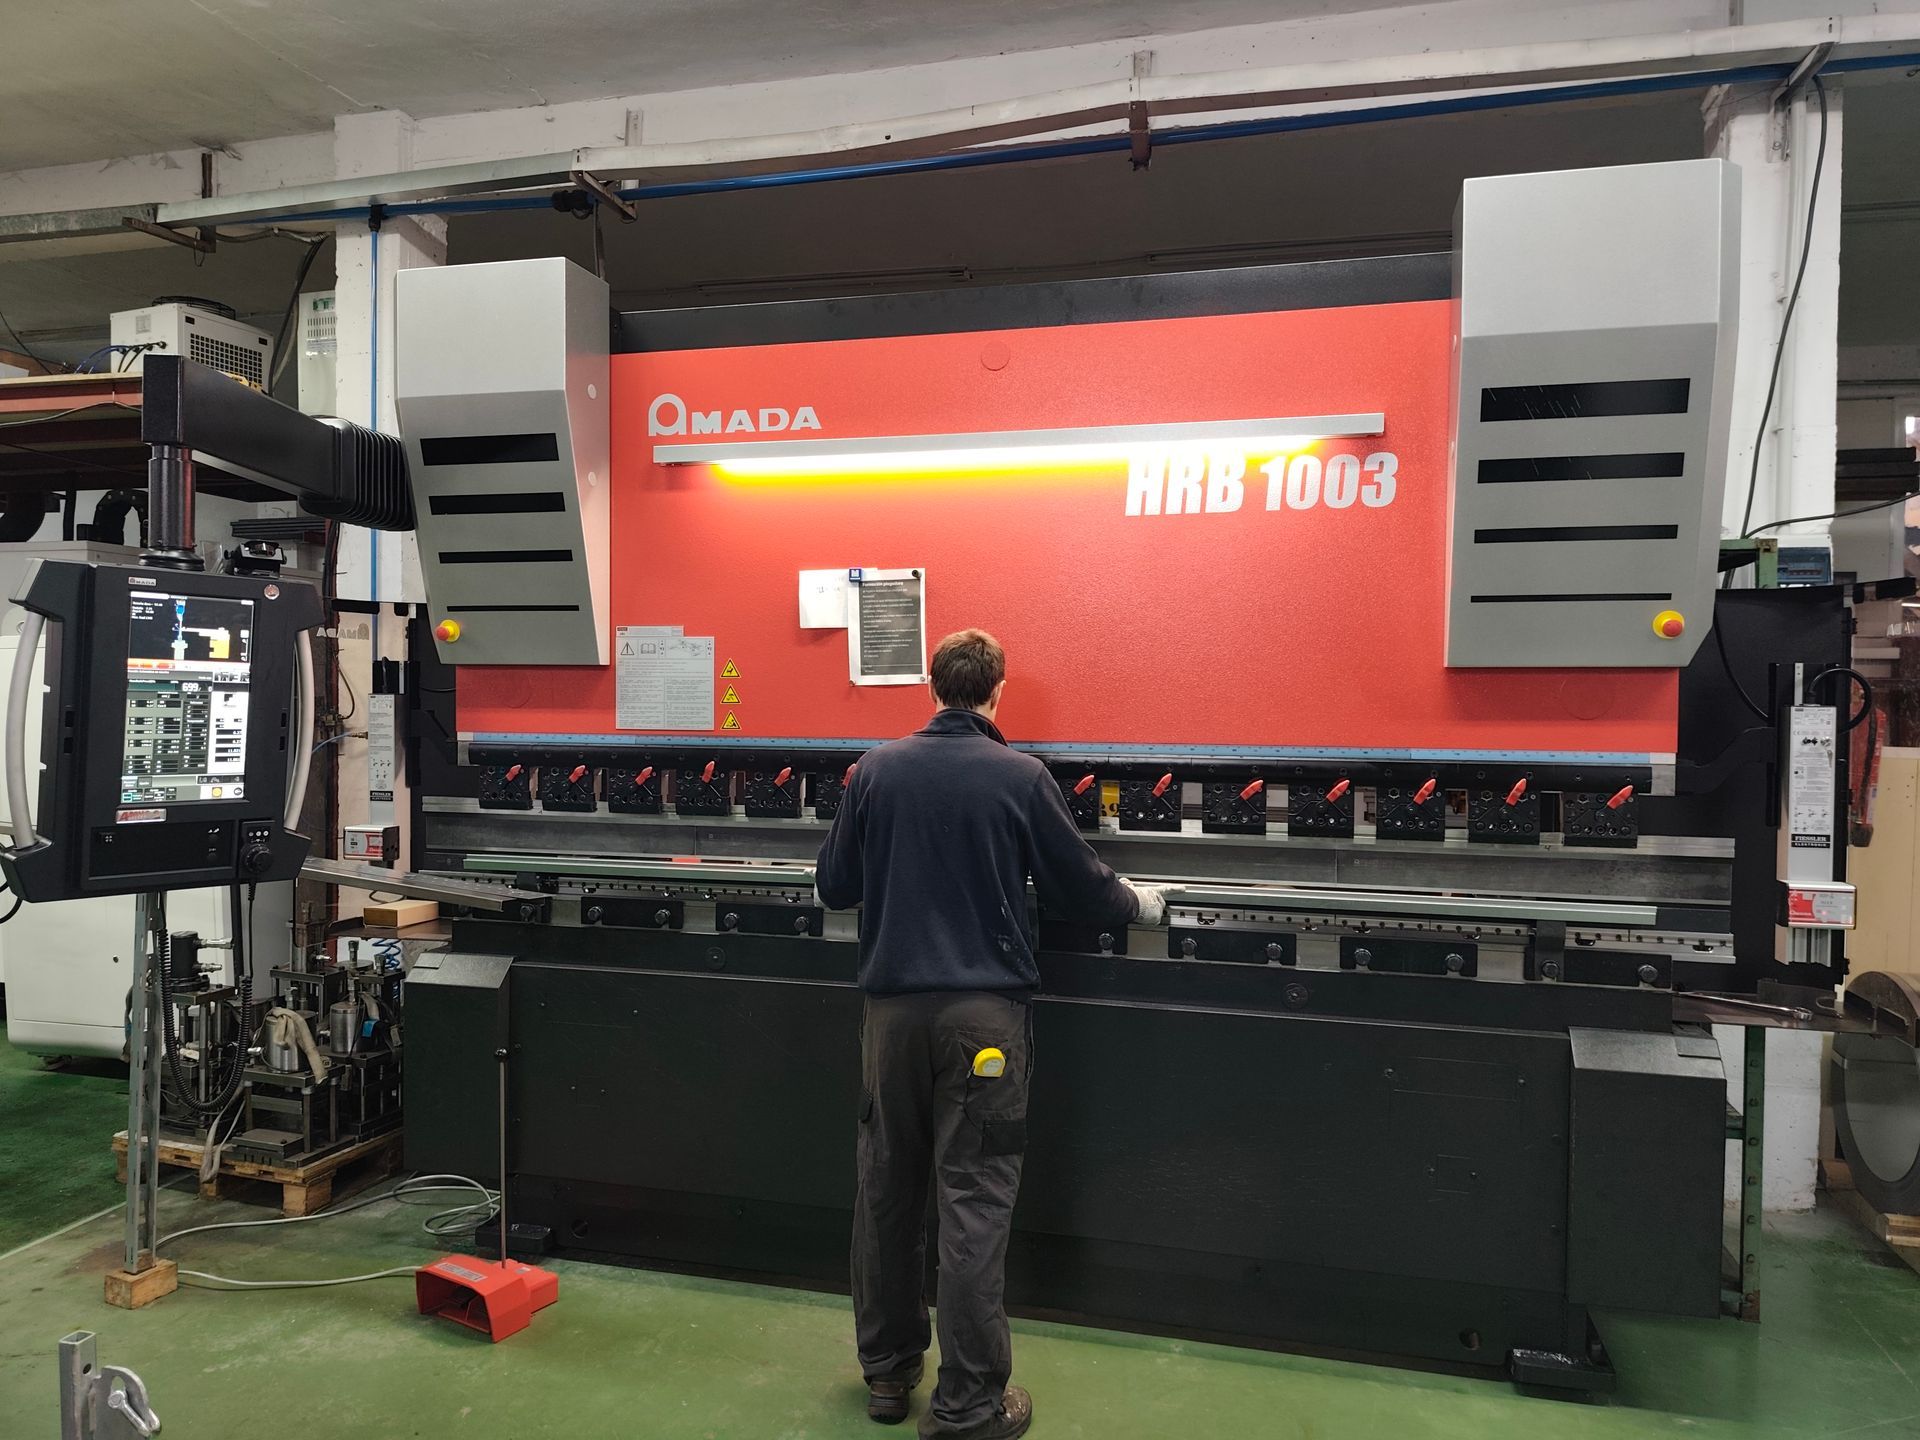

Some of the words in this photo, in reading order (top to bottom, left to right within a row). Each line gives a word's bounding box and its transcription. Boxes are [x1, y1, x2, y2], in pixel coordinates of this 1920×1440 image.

[647, 393, 823, 437] AMADA
[1124, 456, 1247, 517] HRB
[1259, 451, 1399, 512] 1003
